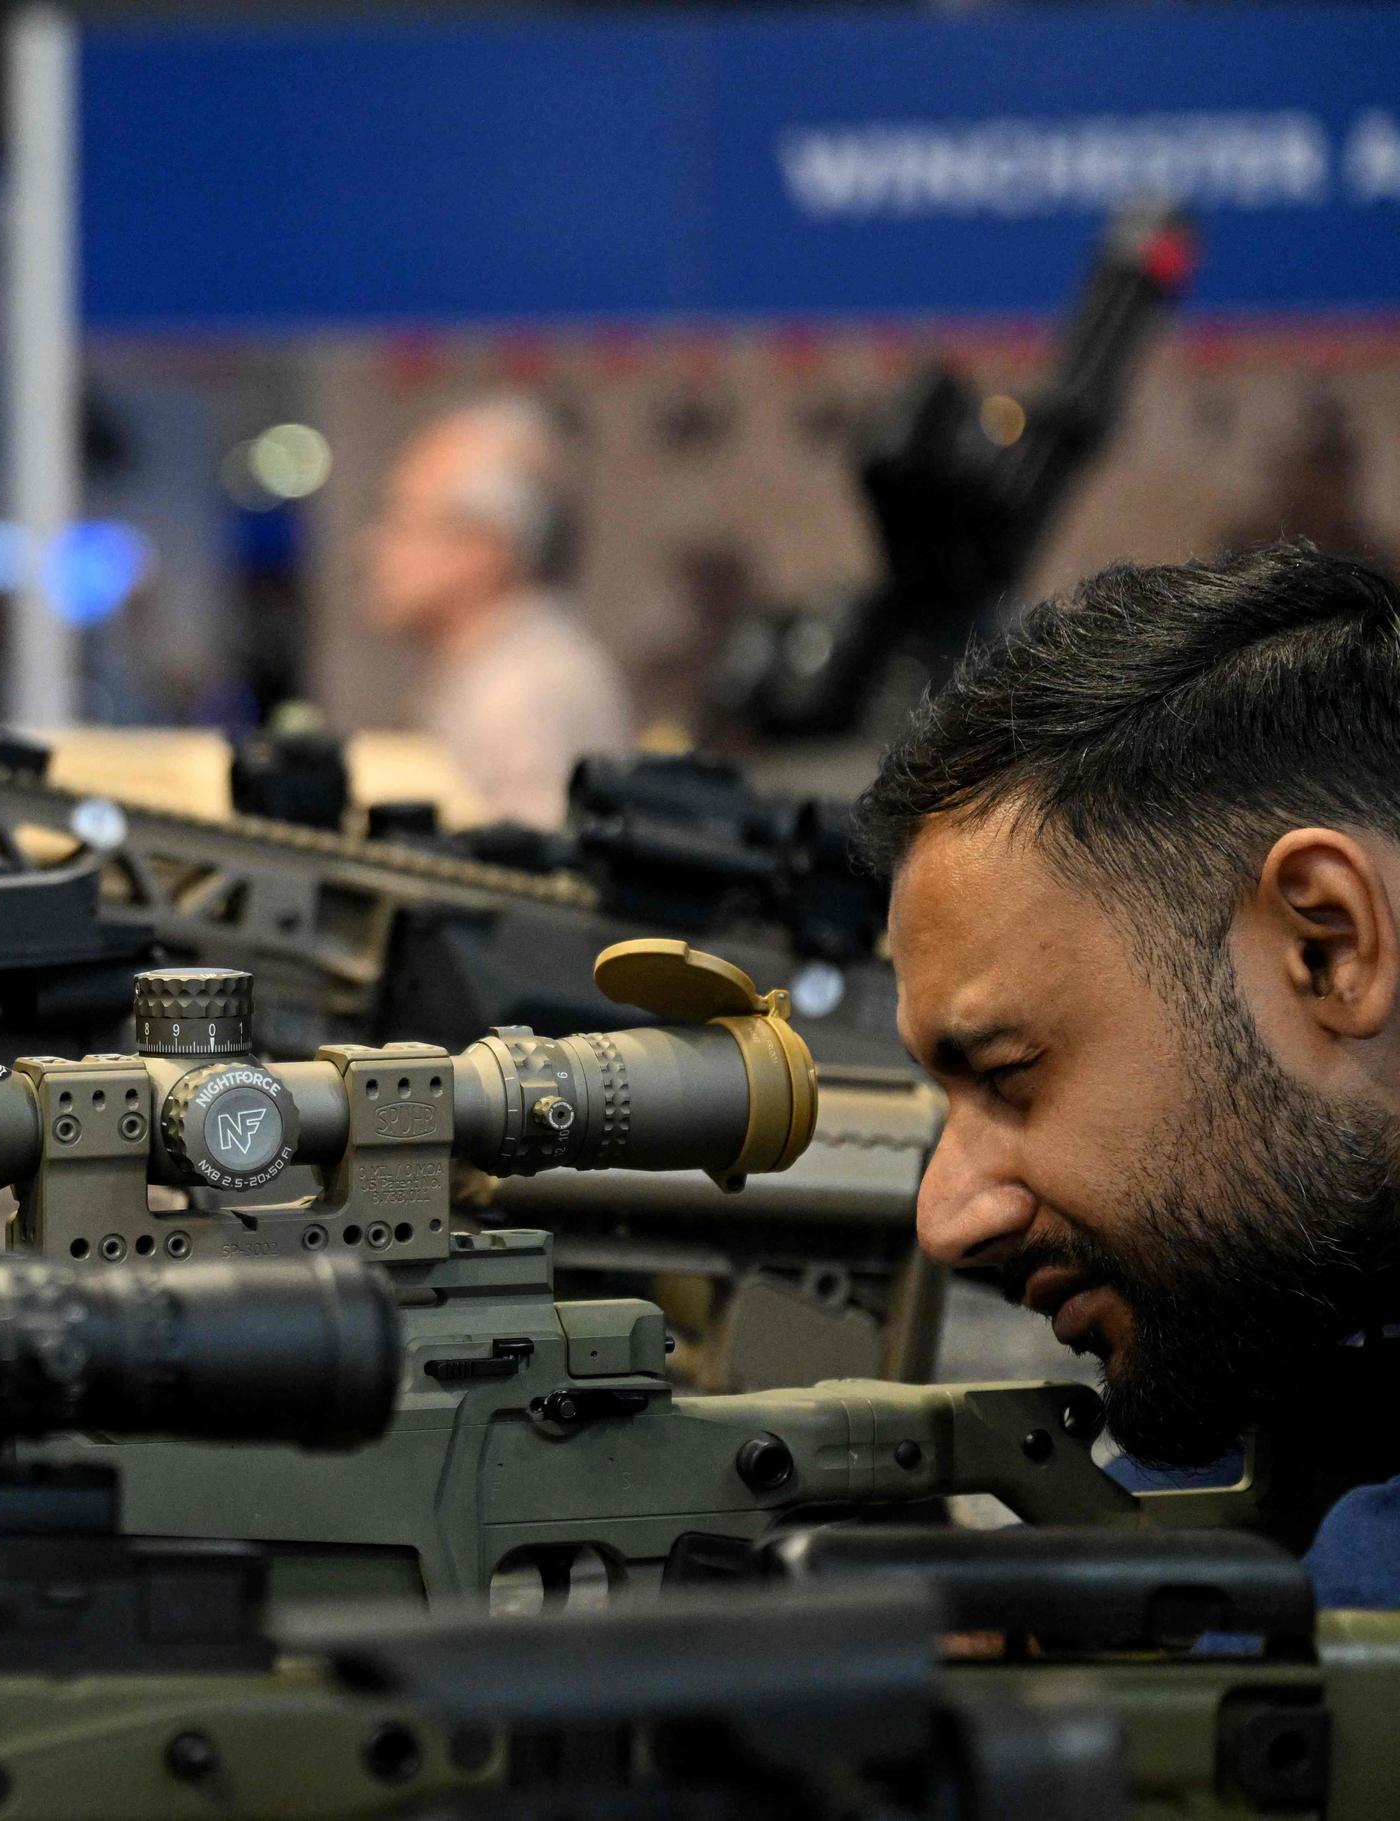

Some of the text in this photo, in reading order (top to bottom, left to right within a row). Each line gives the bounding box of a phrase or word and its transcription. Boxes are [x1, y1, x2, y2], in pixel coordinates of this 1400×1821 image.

[144, 1022, 150, 1036] 8
[172, 1023, 180, 1037] 9
[208, 1023, 216, 1037] 0
[196, 1071, 281, 1107] NIGHTFORCE
